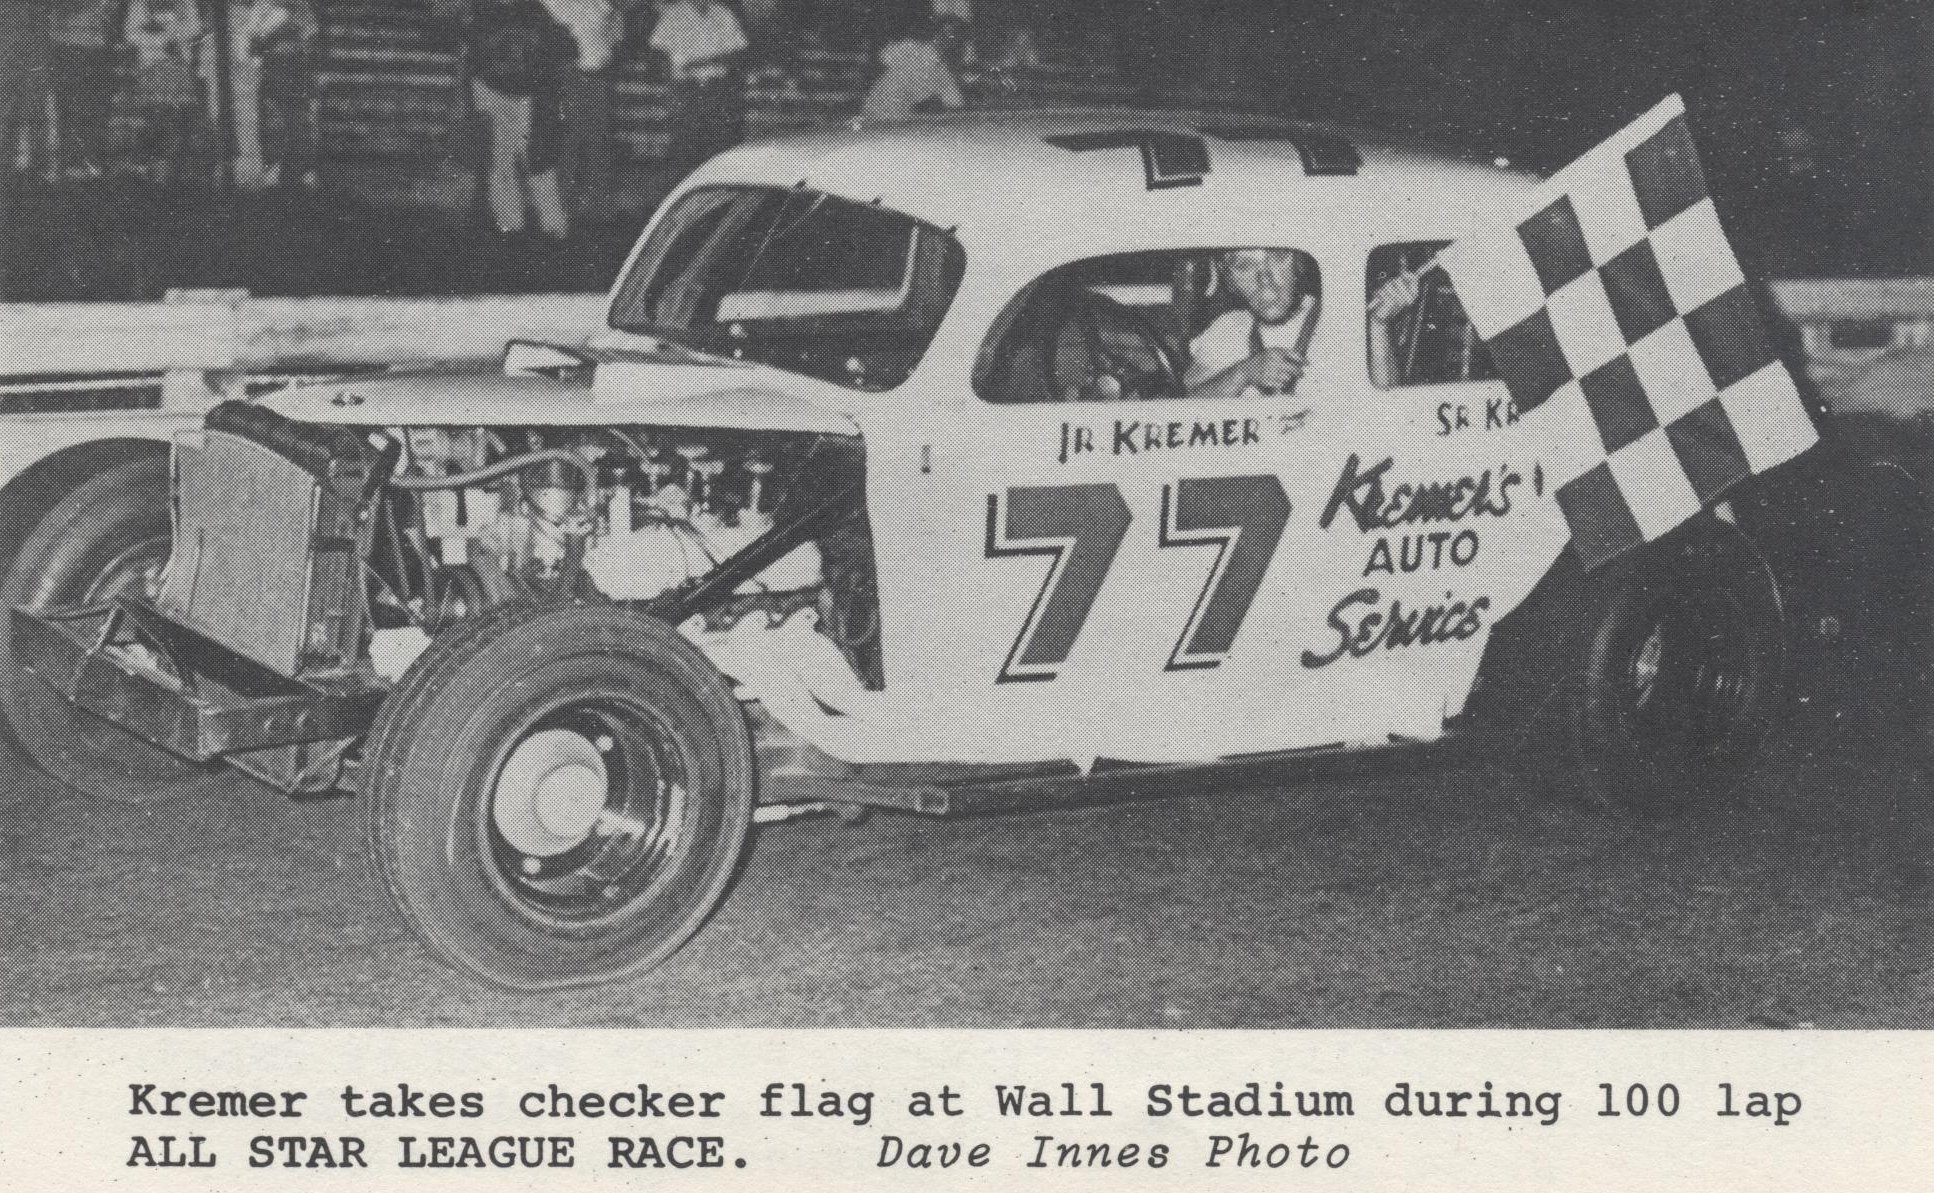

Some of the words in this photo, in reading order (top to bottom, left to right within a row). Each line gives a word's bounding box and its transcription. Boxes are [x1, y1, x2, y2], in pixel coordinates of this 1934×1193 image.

[1057, 421, 1094, 465] JR
[1113, 417, 1261, 456] KREMER
[1437, 402, 1470, 436] SR
[1362, 529, 1480, 577] AUTO
[984, 474, 1295, 684] 77
[1299, 588, 1492, 669] Service
